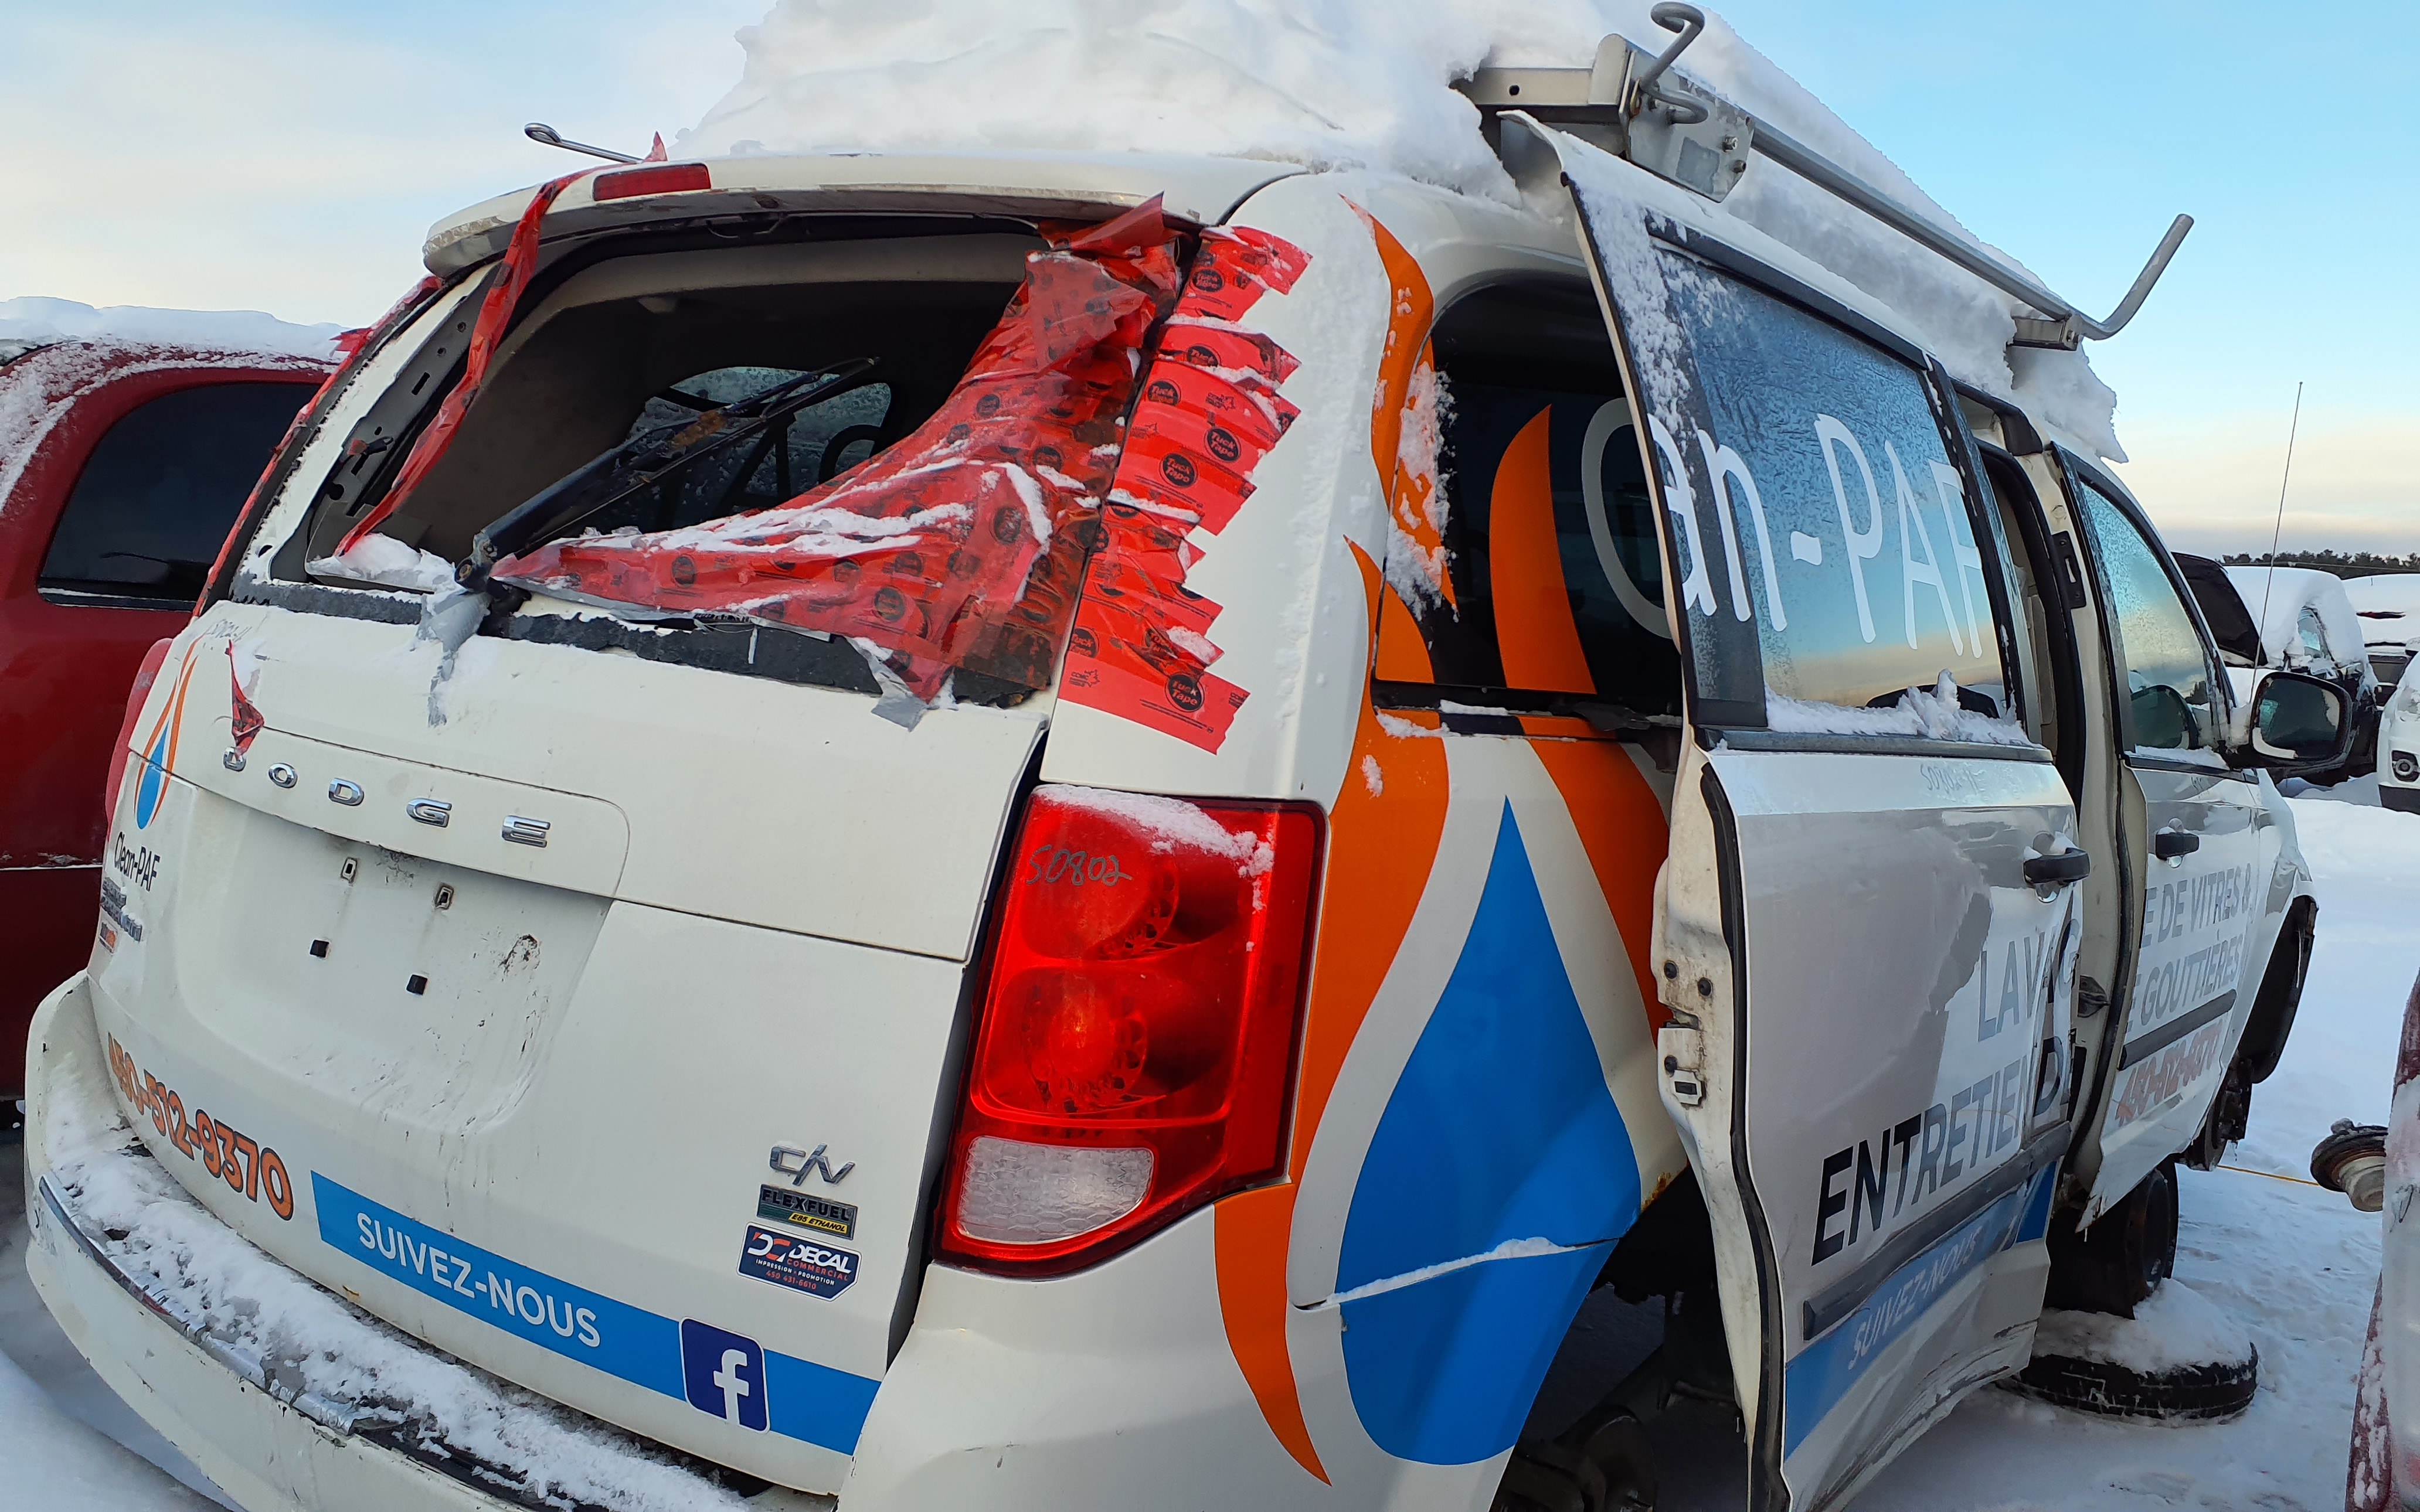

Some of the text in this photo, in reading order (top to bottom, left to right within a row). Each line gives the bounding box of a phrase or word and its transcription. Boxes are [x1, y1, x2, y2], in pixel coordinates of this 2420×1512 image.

[1211, 431, 1236, 450] Tuck
[1165, 467, 1190, 483] Tape
[1167, 458, 1191, 475] Tuck
[1172, 690, 1198, 706] Tape
[1173, 680, 1199, 697] Tuck
[223, 746, 550, 847] DODGE
[114, 831, 161, 892] Clean-PAF
[2158, 879, 2188, 944] DE
[2190, 864, 2241, 932] VITRES
[762, 1188, 849, 1221] FLEXFUEL
[791, 1213, 846, 1232] E85 ETHANOL
[788, 1243, 852, 1274] DECAL
[357, 1213, 601, 1347] SUIVEZ-NOUS
[756, 1258, 835, 1286] IMPRESSION PROMOTION
[766, 1270, 781, 1280] 450
[786, 1259, 849, 1282] COMMERCIAL
